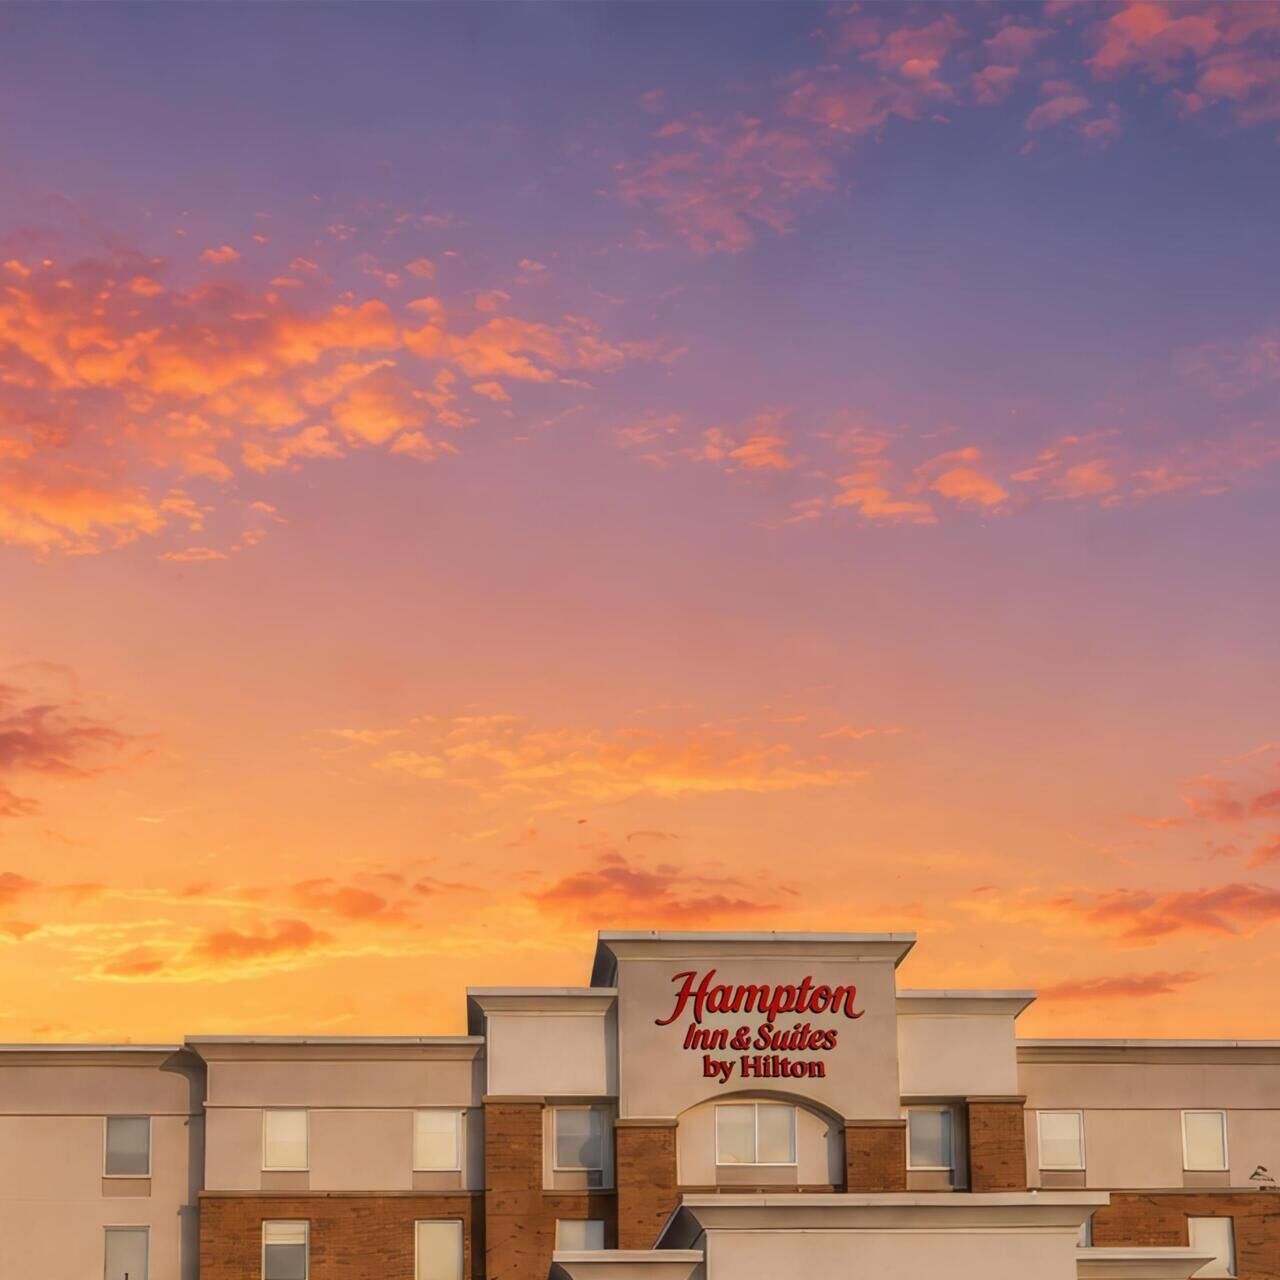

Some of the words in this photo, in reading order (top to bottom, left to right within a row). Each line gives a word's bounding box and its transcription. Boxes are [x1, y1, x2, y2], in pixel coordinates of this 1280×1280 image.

[654, 968, 865, 1026] Hampton
[683, 1022, 729, 1050] Inn
[730, 1026, 752, 1050] &
[753, 1022, 838, 1050] Suites
[703, 1055, 736, 1084] by
[740, 1055, 826, 1078] Hilton
